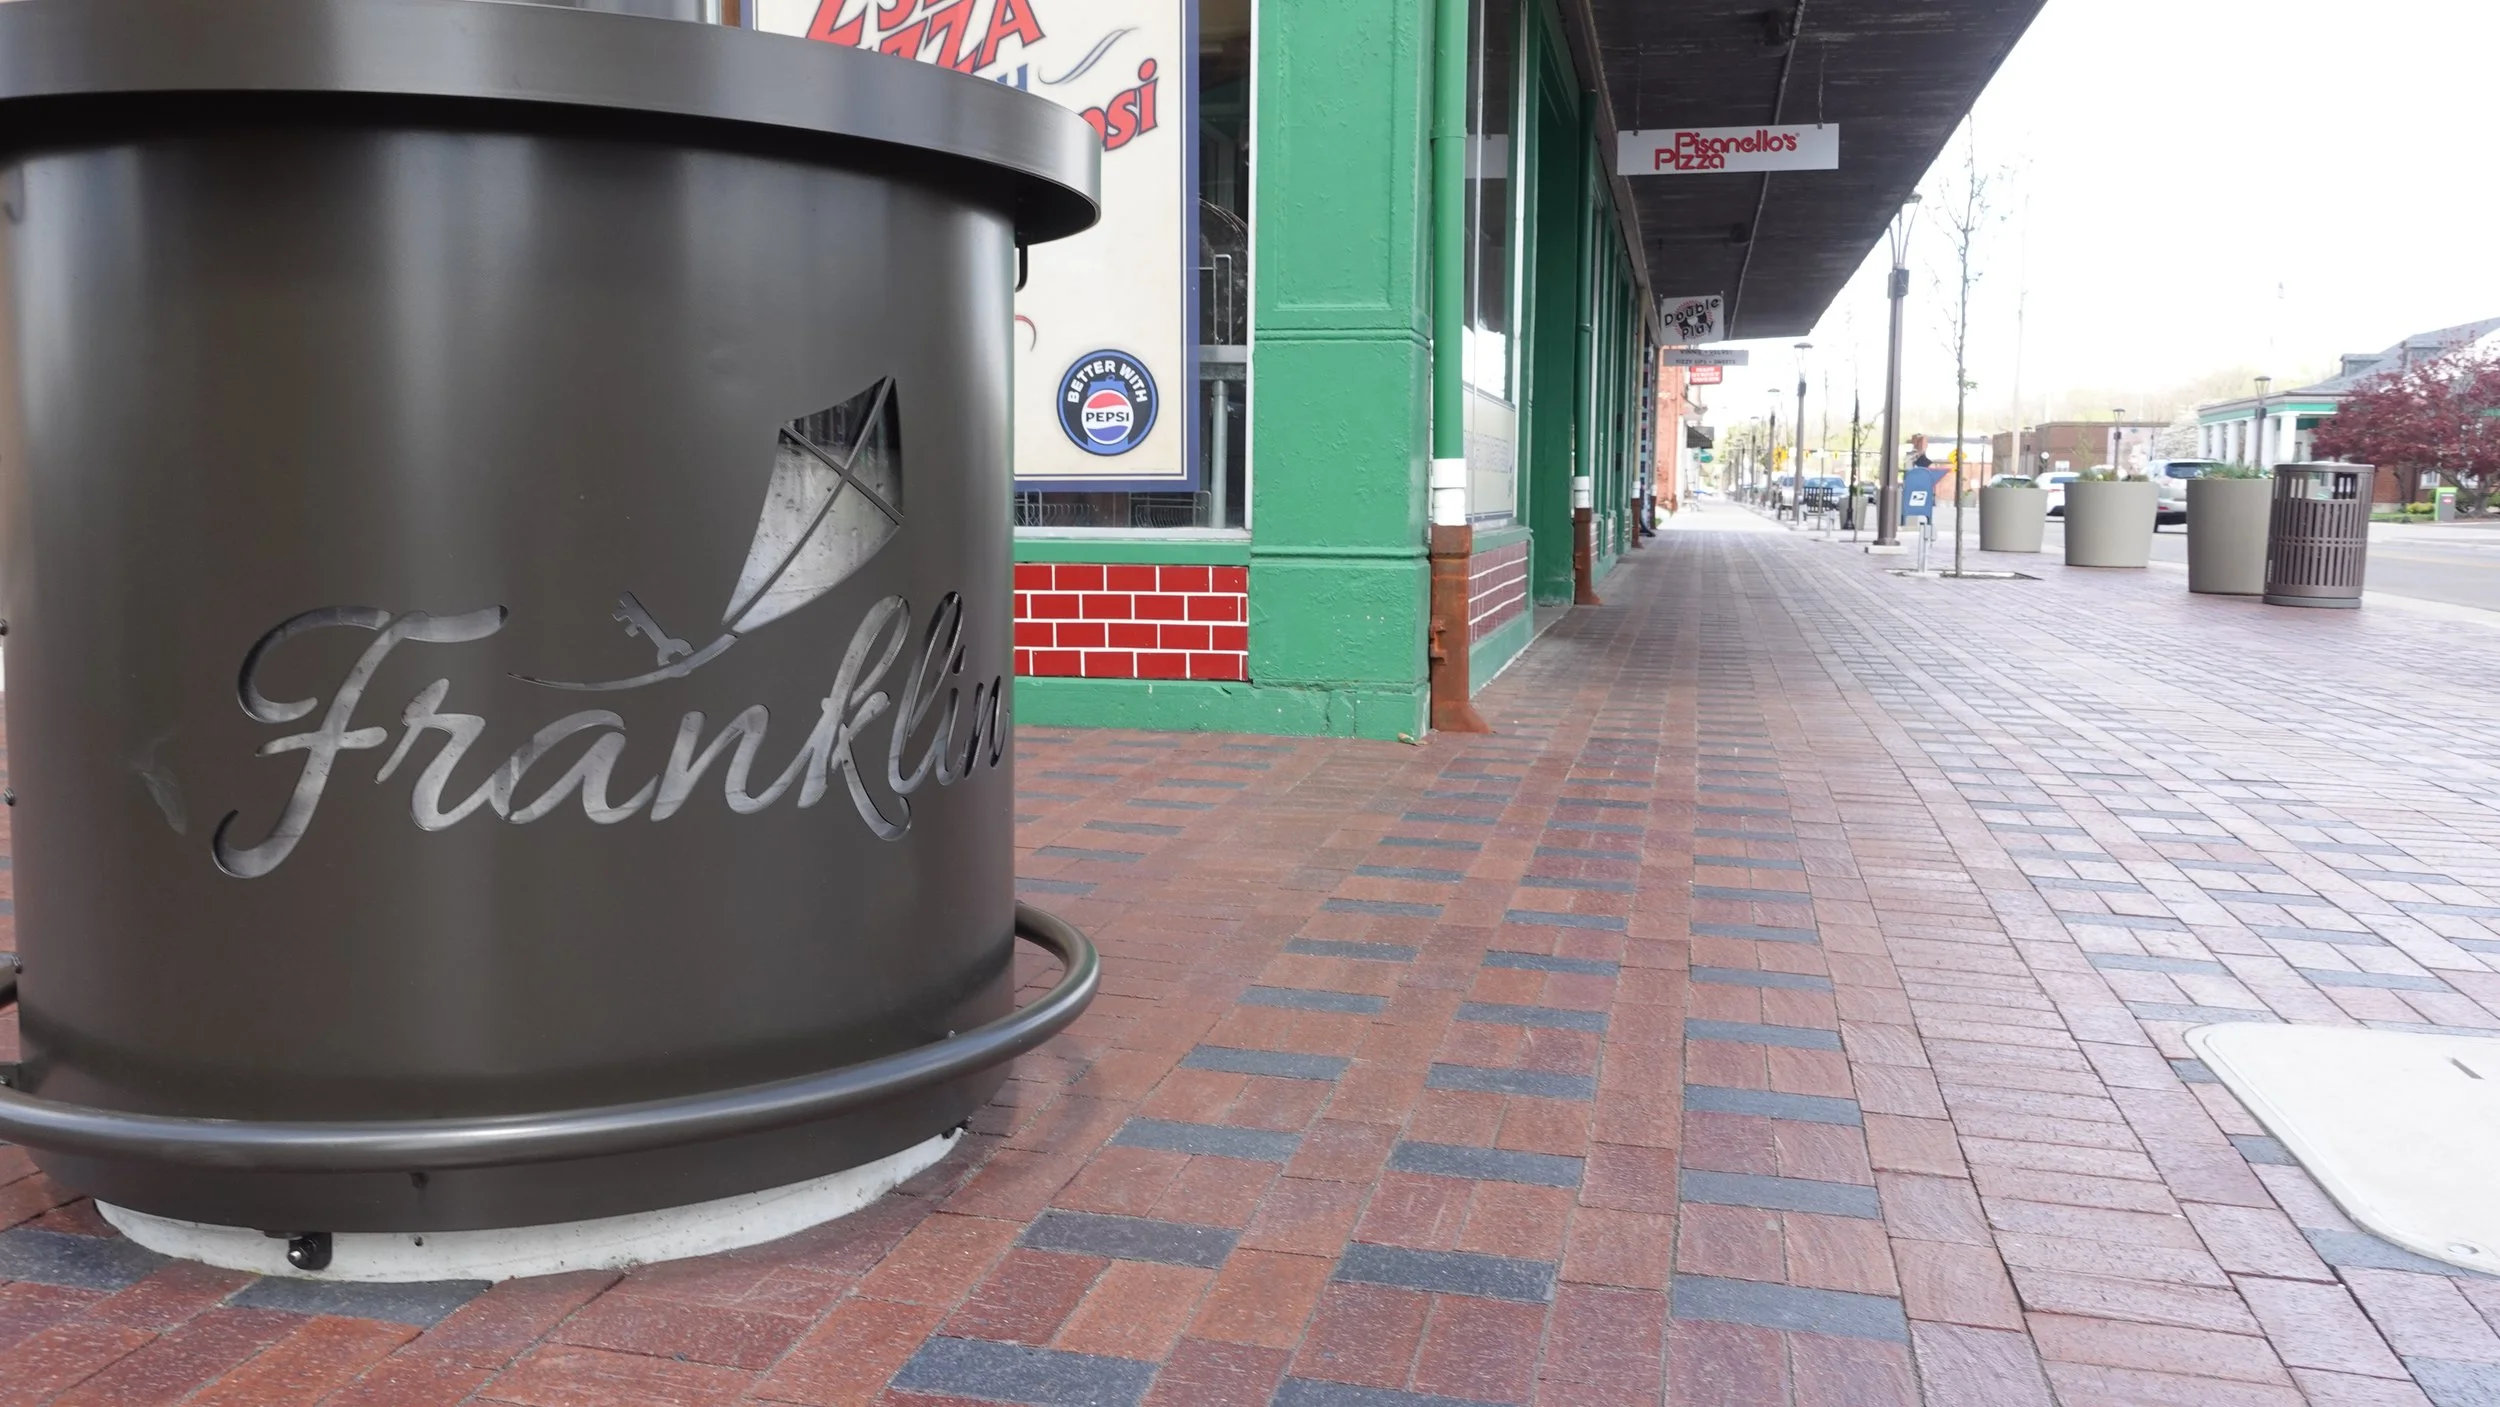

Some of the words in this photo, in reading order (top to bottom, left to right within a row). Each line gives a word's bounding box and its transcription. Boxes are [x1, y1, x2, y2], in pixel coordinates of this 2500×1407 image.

[1674, 129, 1798, 155] Pisanello's
[1664, 298, 1720, 327] Double
[1682, 320, 1714, 340] Play
[1067, 359, 1117, 404] BETTER
[1119, 363, 1149, 403] WITH
[1085, 411, 1130, 423] PEPSI
[210, 590, 1011, 880] Franklin
